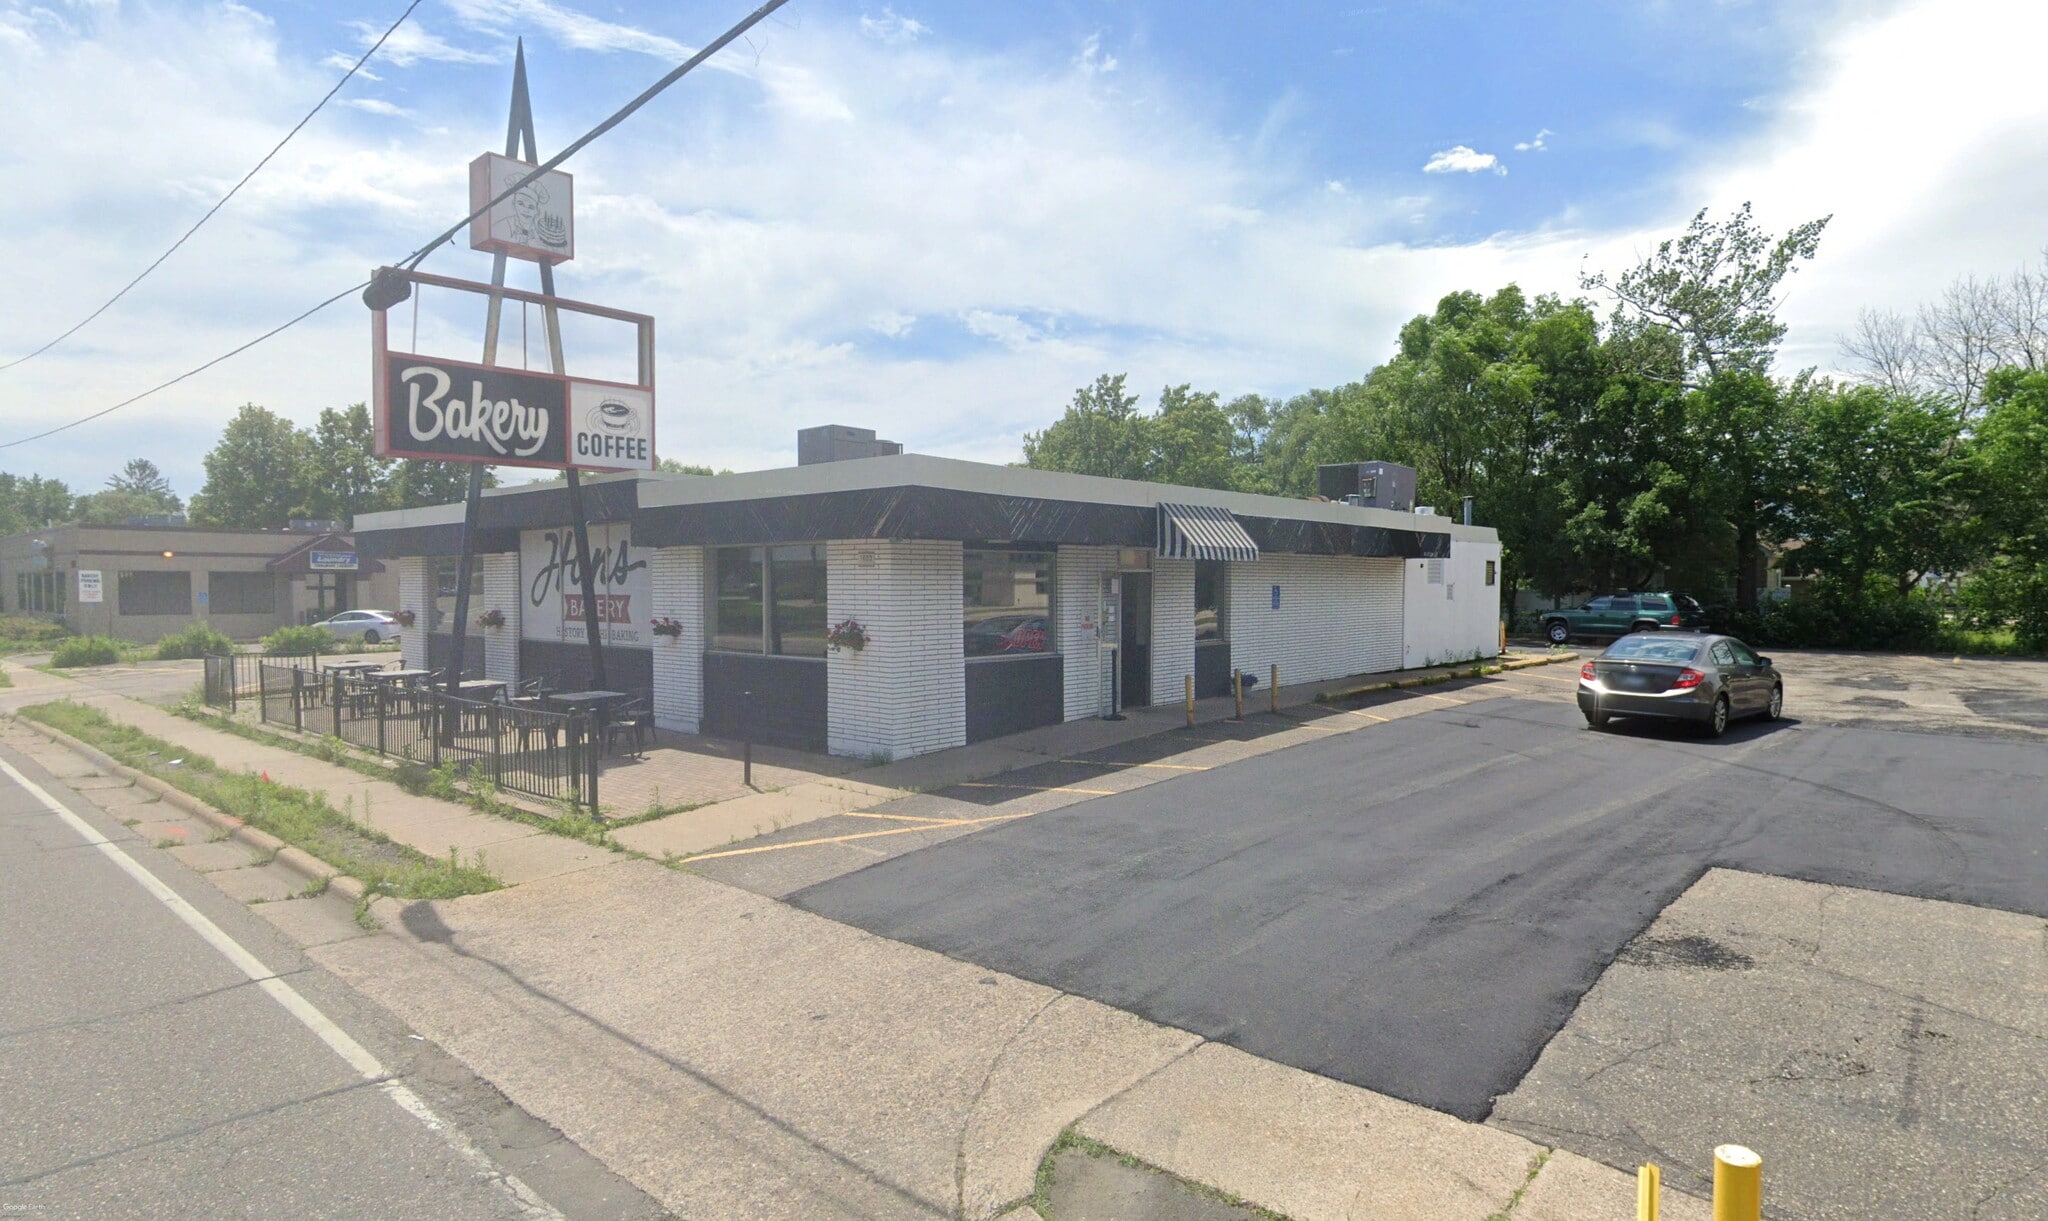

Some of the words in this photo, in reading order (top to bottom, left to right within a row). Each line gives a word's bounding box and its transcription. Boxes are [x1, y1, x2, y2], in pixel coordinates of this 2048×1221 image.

[401, 366, 549, 457] Bakery
[577, 432, 647, 461] COFFEE
[570, 599, 625, 618] BAERY
[556, 626, 585, 639] HSTORY
[611, 630, 640, 642] BAKING
